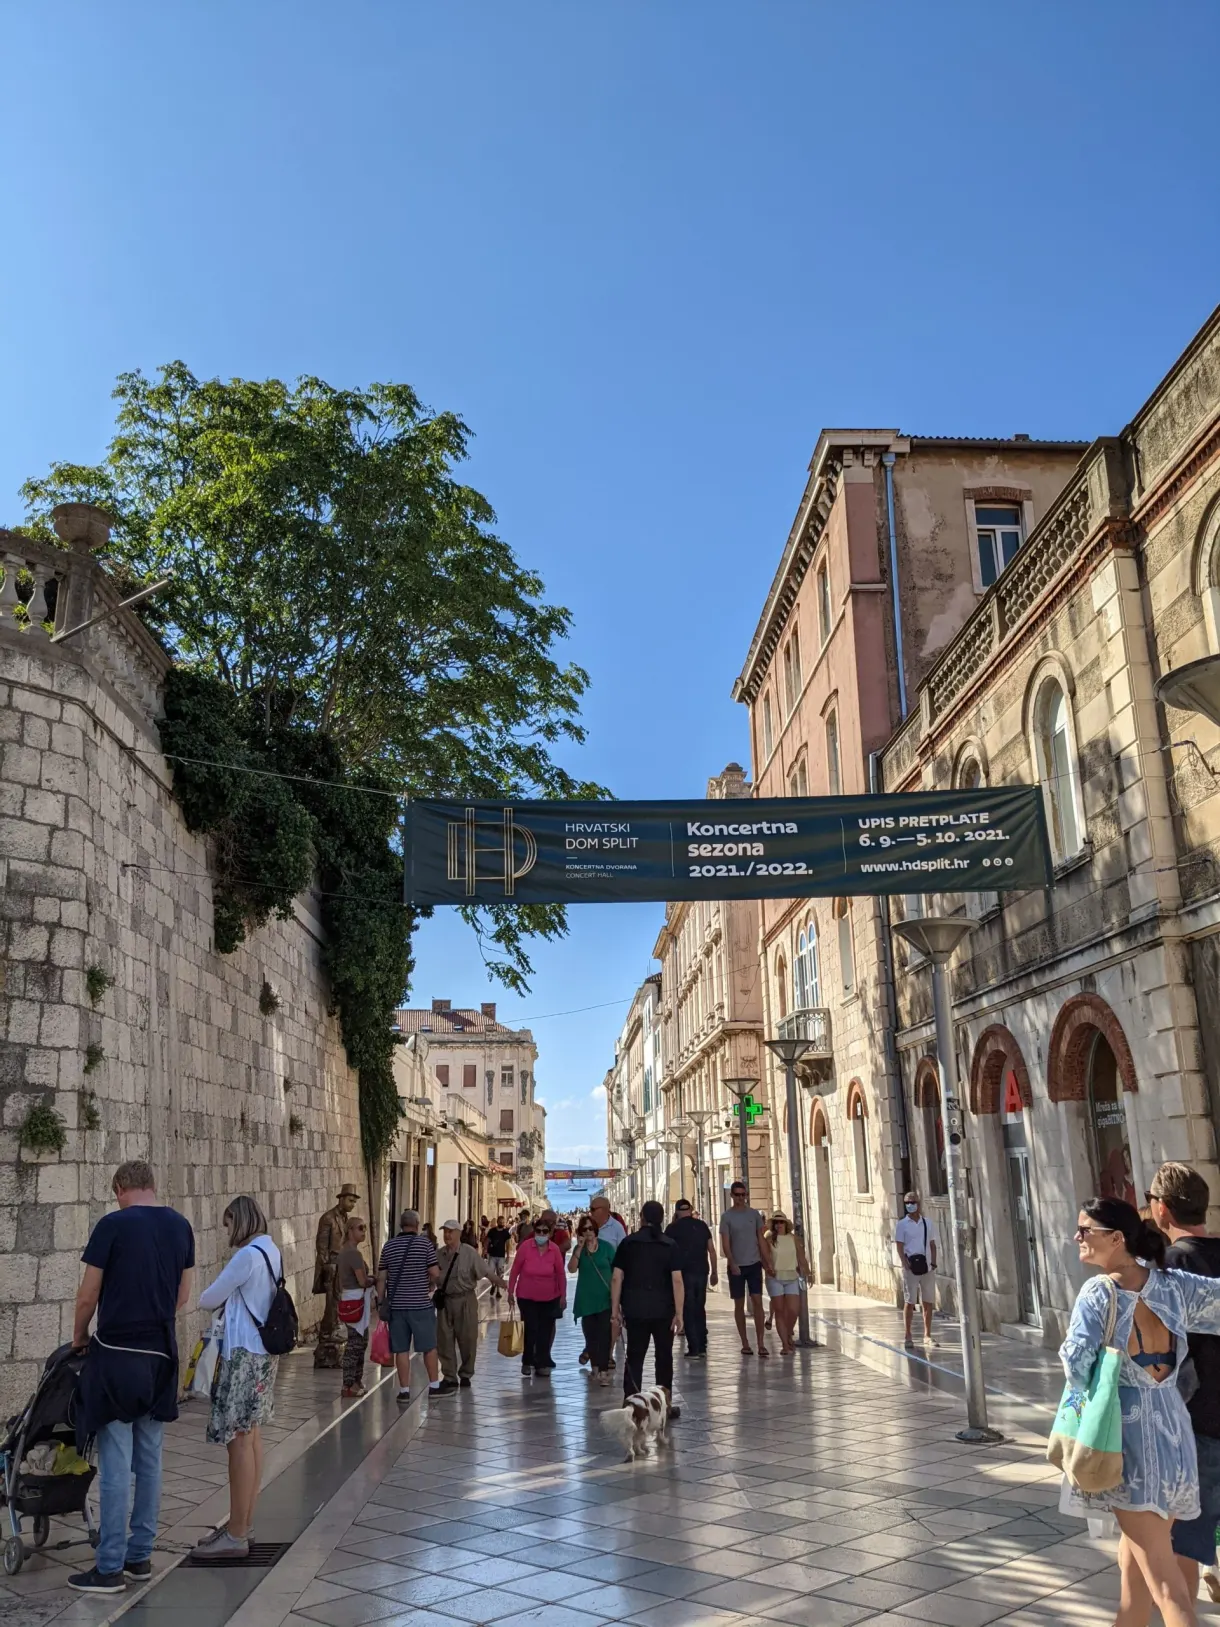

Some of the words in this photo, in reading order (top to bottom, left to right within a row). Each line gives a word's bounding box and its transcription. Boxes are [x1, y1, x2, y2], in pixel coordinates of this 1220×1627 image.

[565, 823, 630, 833] HRVATSKI
[858, 816, 895, 829] UPIS
[899, 812, 989, 828] PRETPLATE
[687, 821, 798, 836] Koncertna
[565, 837, 599, 850] DOM
[602, 837, 639, 849] SPLIT
[859, 833, 876, 847] 6.
[935, 832, 960, 843] 10.
[964, 829, 1010, 842] 2021.
[688, 842, 764, 857] sezona
[689, 861, 814, 877] 2021./2022.
[860, 858, 970, 873] www.hdsplit.hr
